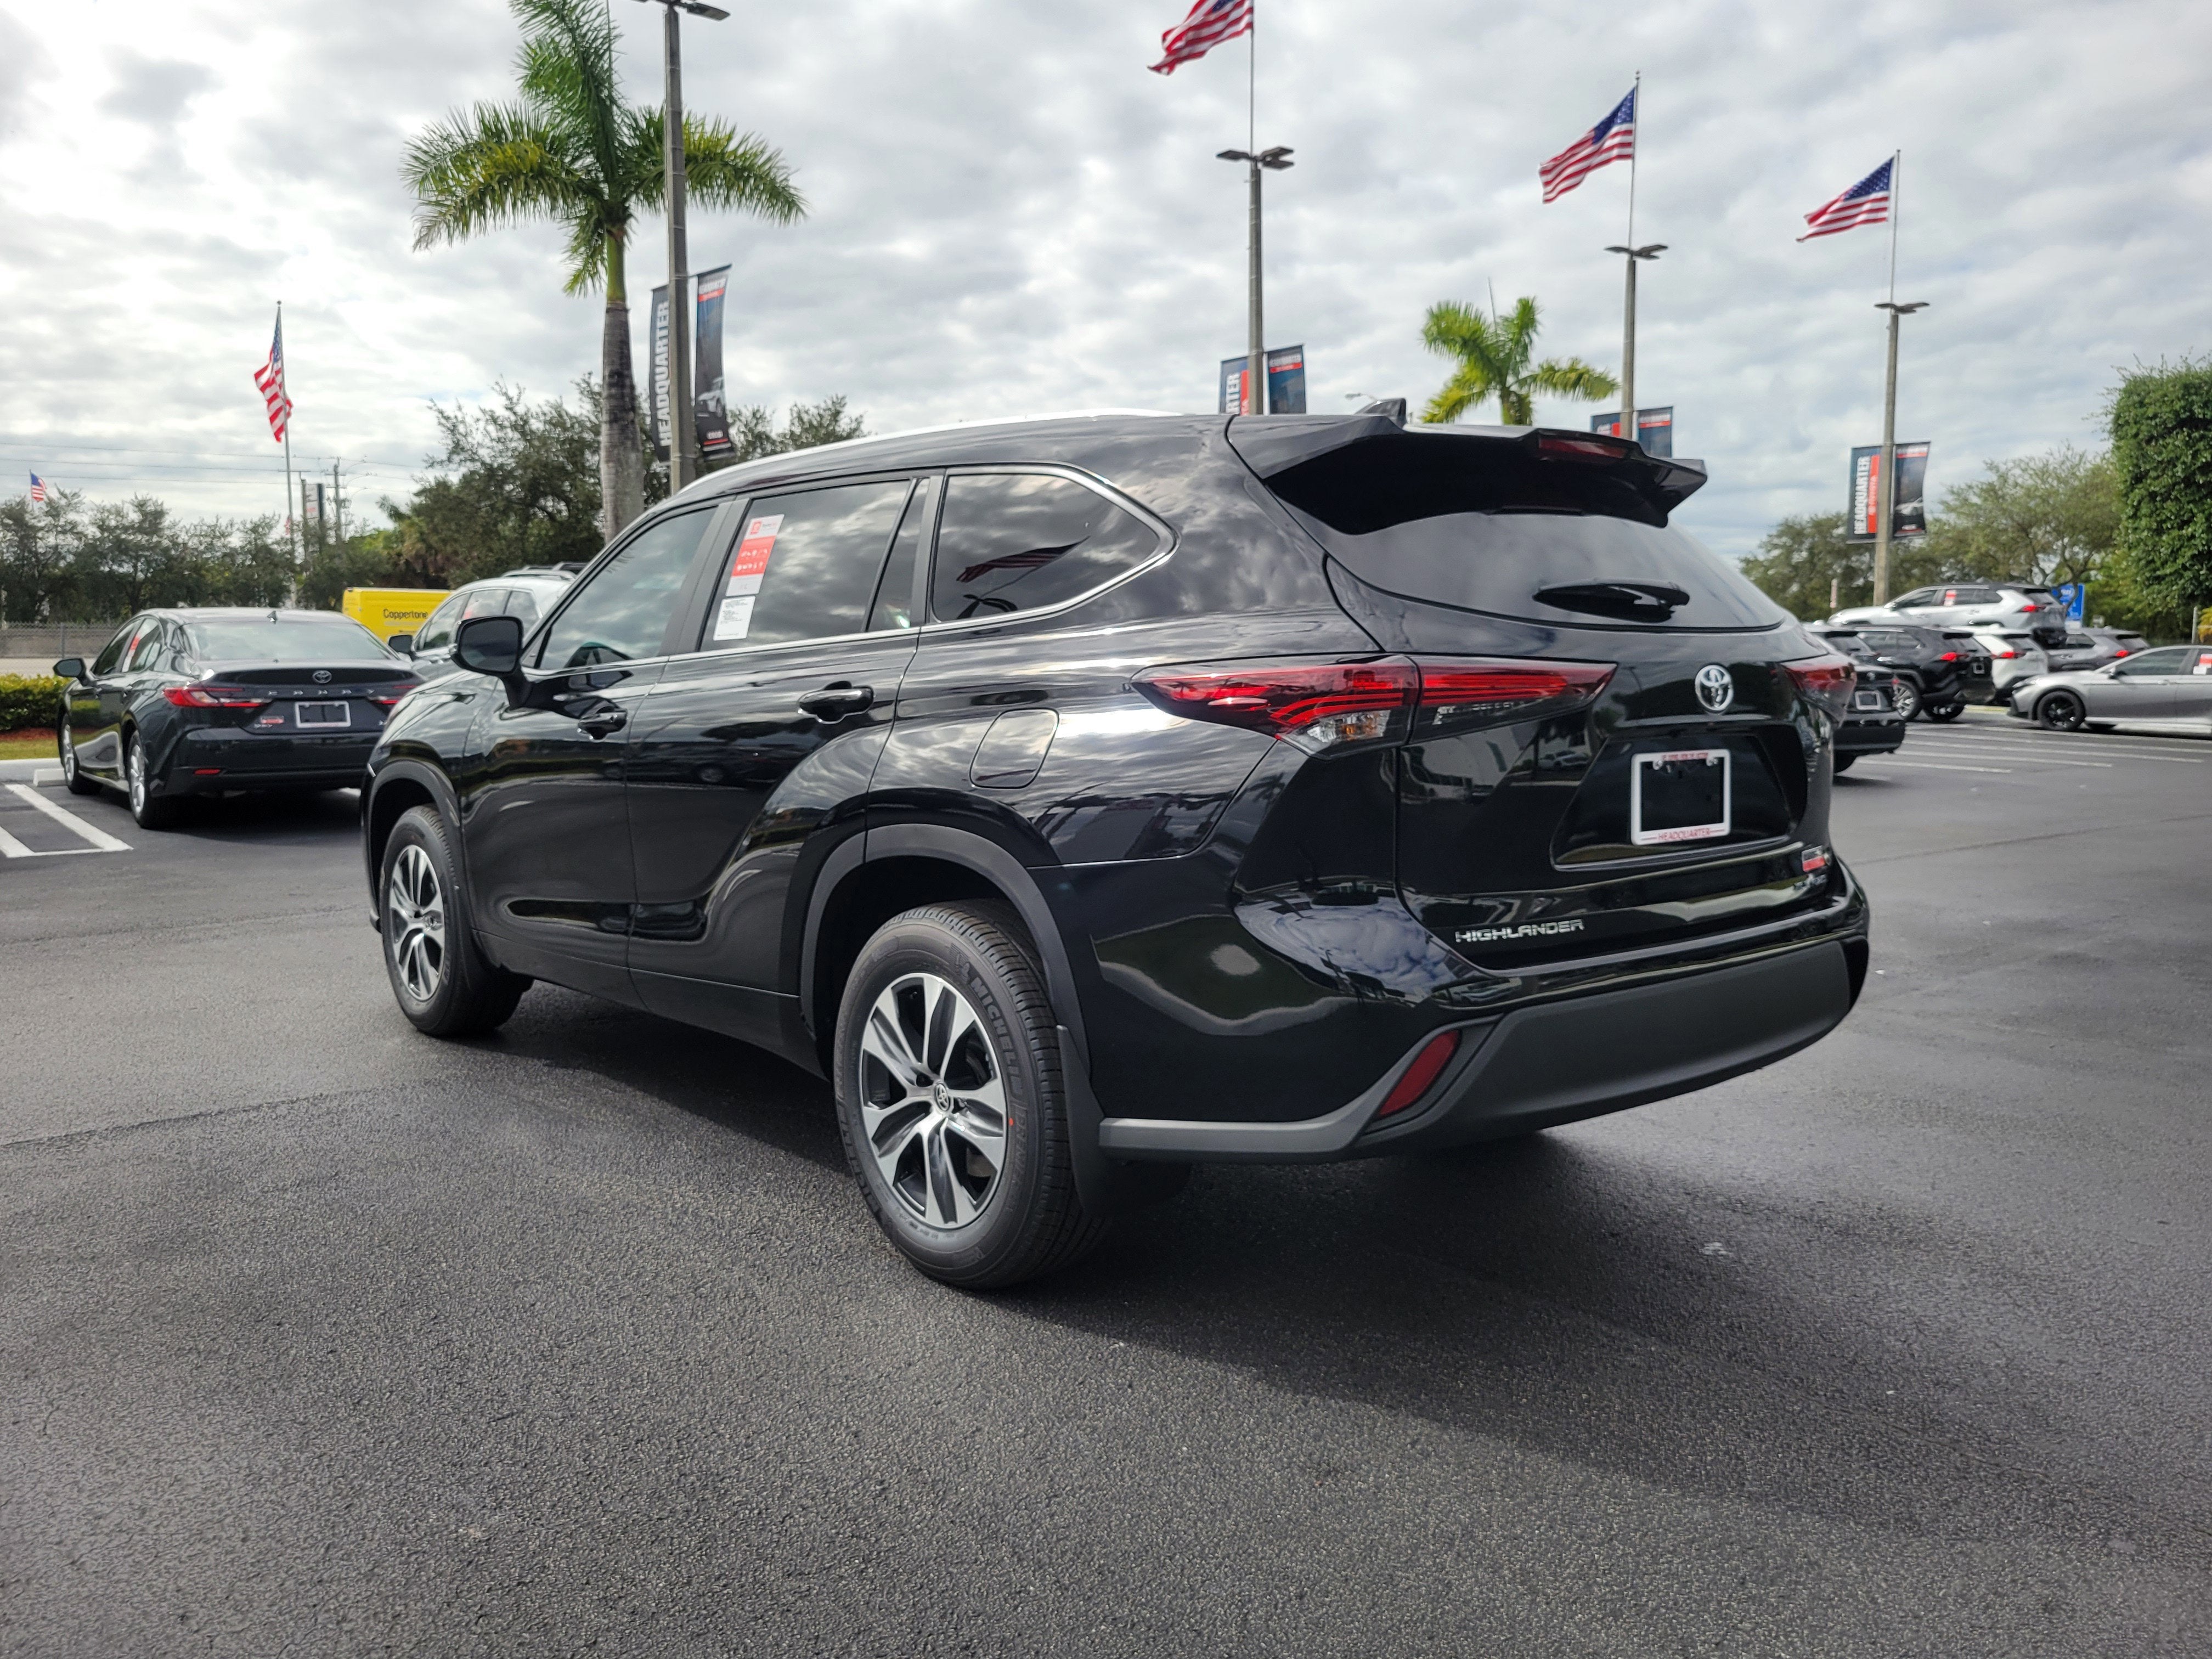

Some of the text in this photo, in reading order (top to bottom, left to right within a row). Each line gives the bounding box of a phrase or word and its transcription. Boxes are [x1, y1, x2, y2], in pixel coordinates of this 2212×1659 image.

[654, 300, 673, 447] HEADQUARTER
[383, 608, 428, 619] Coppertone
[1658, 827, 1711, 841] HEADQUARTER
[1455, 919, 1585, 943] HIGHLANDER
[970, 977, 1023, 1094] MICHELIN
